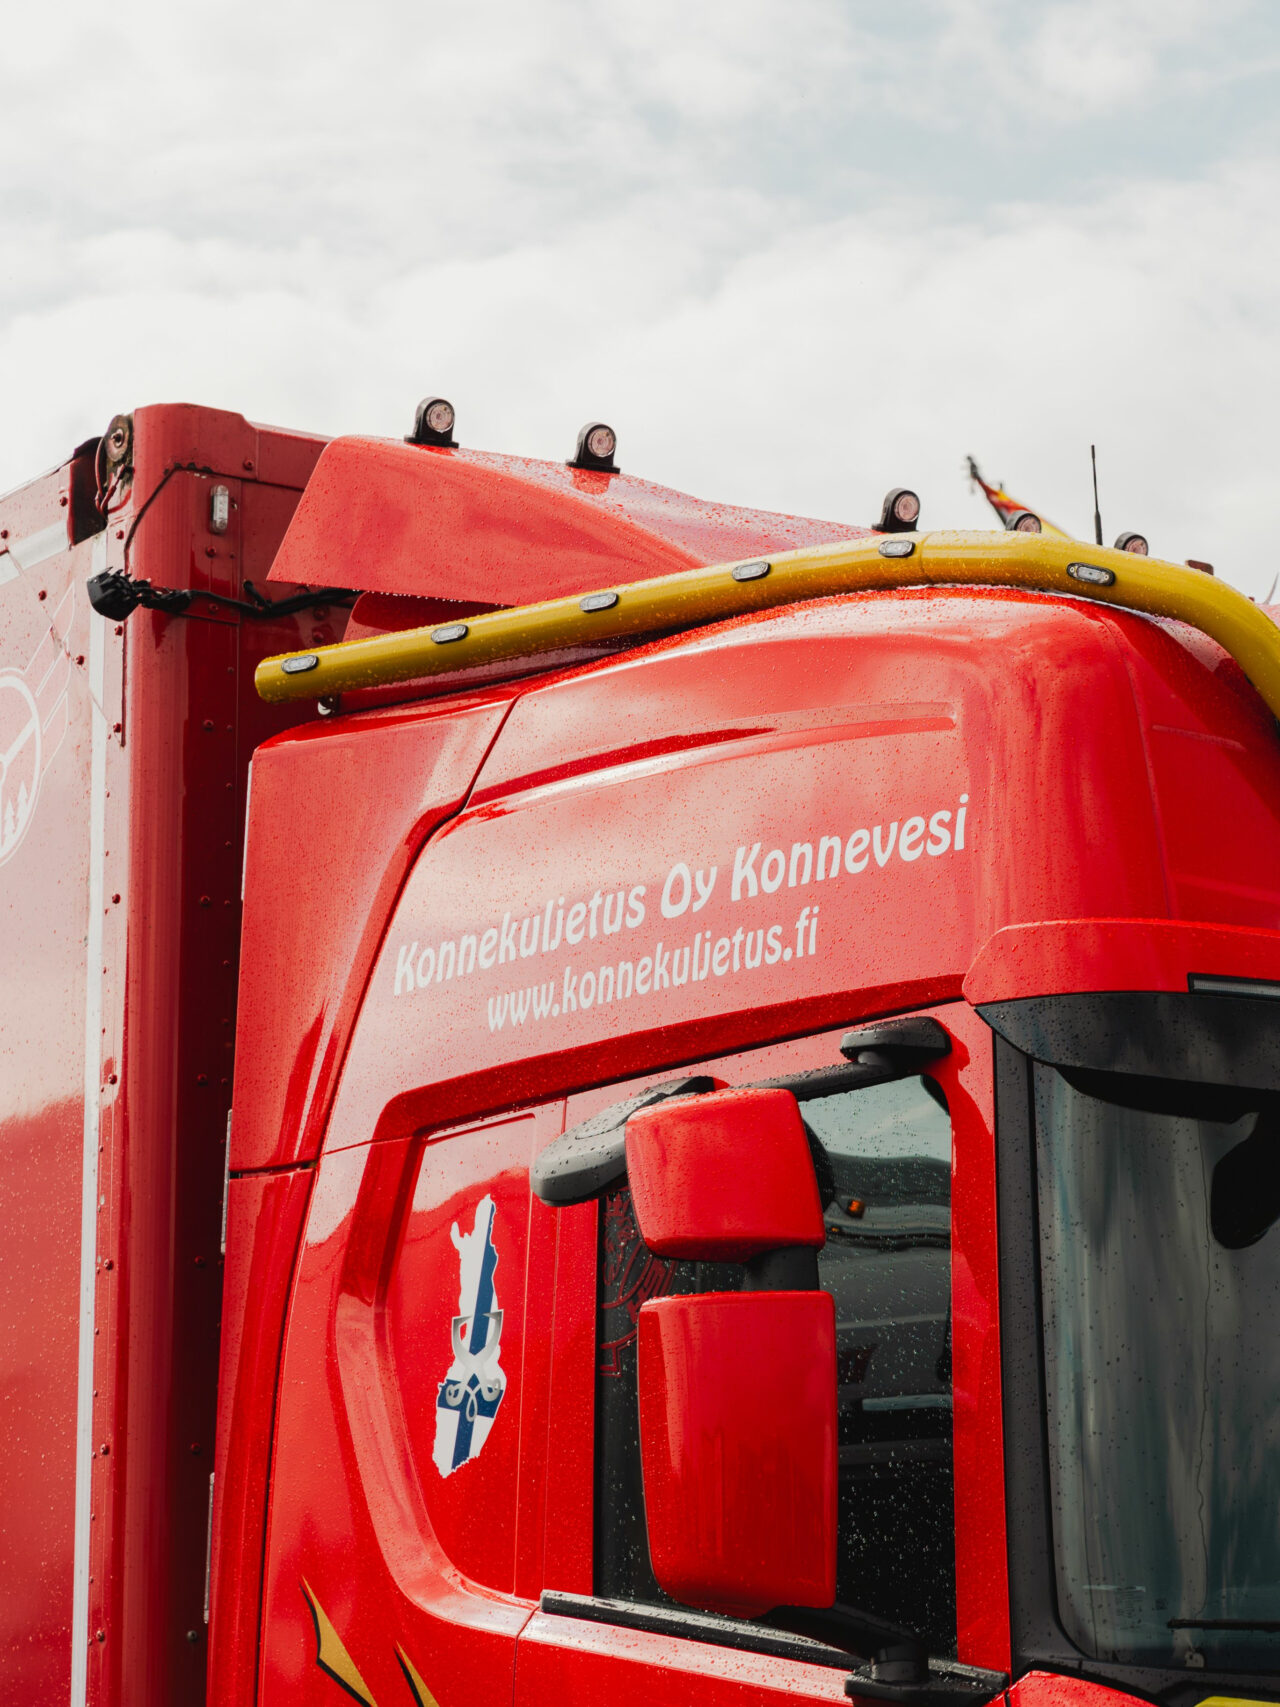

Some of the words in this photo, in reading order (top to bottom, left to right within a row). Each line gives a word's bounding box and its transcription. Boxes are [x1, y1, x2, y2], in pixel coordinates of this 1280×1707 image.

[393, 883, 646, 996] Konnekuljetus
[660, 862, 718, 919] Oy
[731, 793, 970, 903] Konnevesi
[486, 905, 820, 1034] www.konnekuljetus.fi
